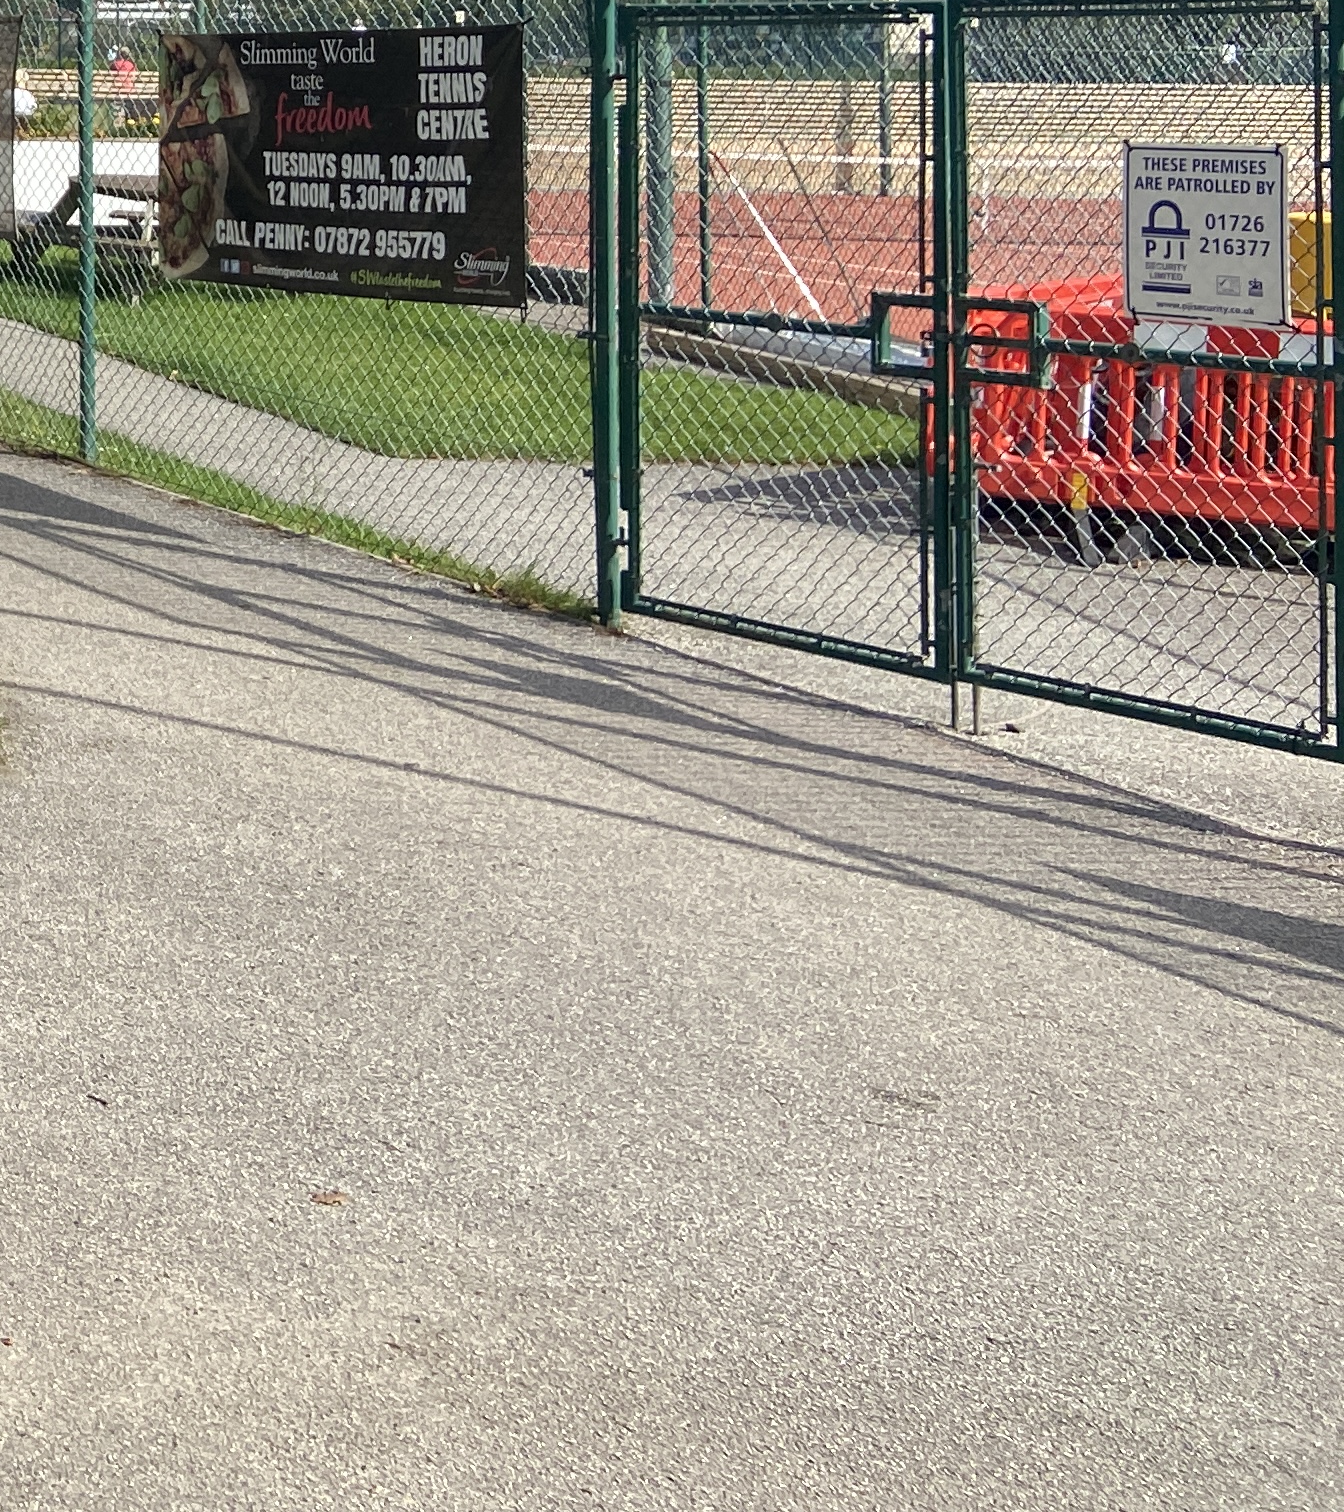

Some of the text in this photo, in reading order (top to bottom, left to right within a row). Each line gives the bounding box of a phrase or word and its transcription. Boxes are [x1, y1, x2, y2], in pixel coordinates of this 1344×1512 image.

[240, 37, 376, 69] Slimming World
[419, 35, 483, 67] HERON
[290, 73, 324, 90] taste
[417, 71, 487, 104] TENNIS
[303, 90, 320, 106] the
[275, 91, 373, 147] freedom
[416, 108, 490, 141] CENTRE
[263, 151, 473, 185] TUESDAYS 9AM, 10.30AM,
[1142, 157, 1267, 175] THESE PREMISES
[267, 180, 467, 214] 12 NOON, 5.30PM & 7PM
[1134, 176, 1276, 196] ARE PATROLLED BY
[1205, 213, 1265, 233] 01726
[215, 219, 446, 261] CALL PENNY: 07872 955779
[1199, 237, 1271, 257] 216377
[253, 264, 339, 281] slimmingworld.co.uk
[454, 252, 510, 287] Slimming
[1145, 262, 1188, 271] SECURITY
[1149, 272, 1183, 281] LIMITED
